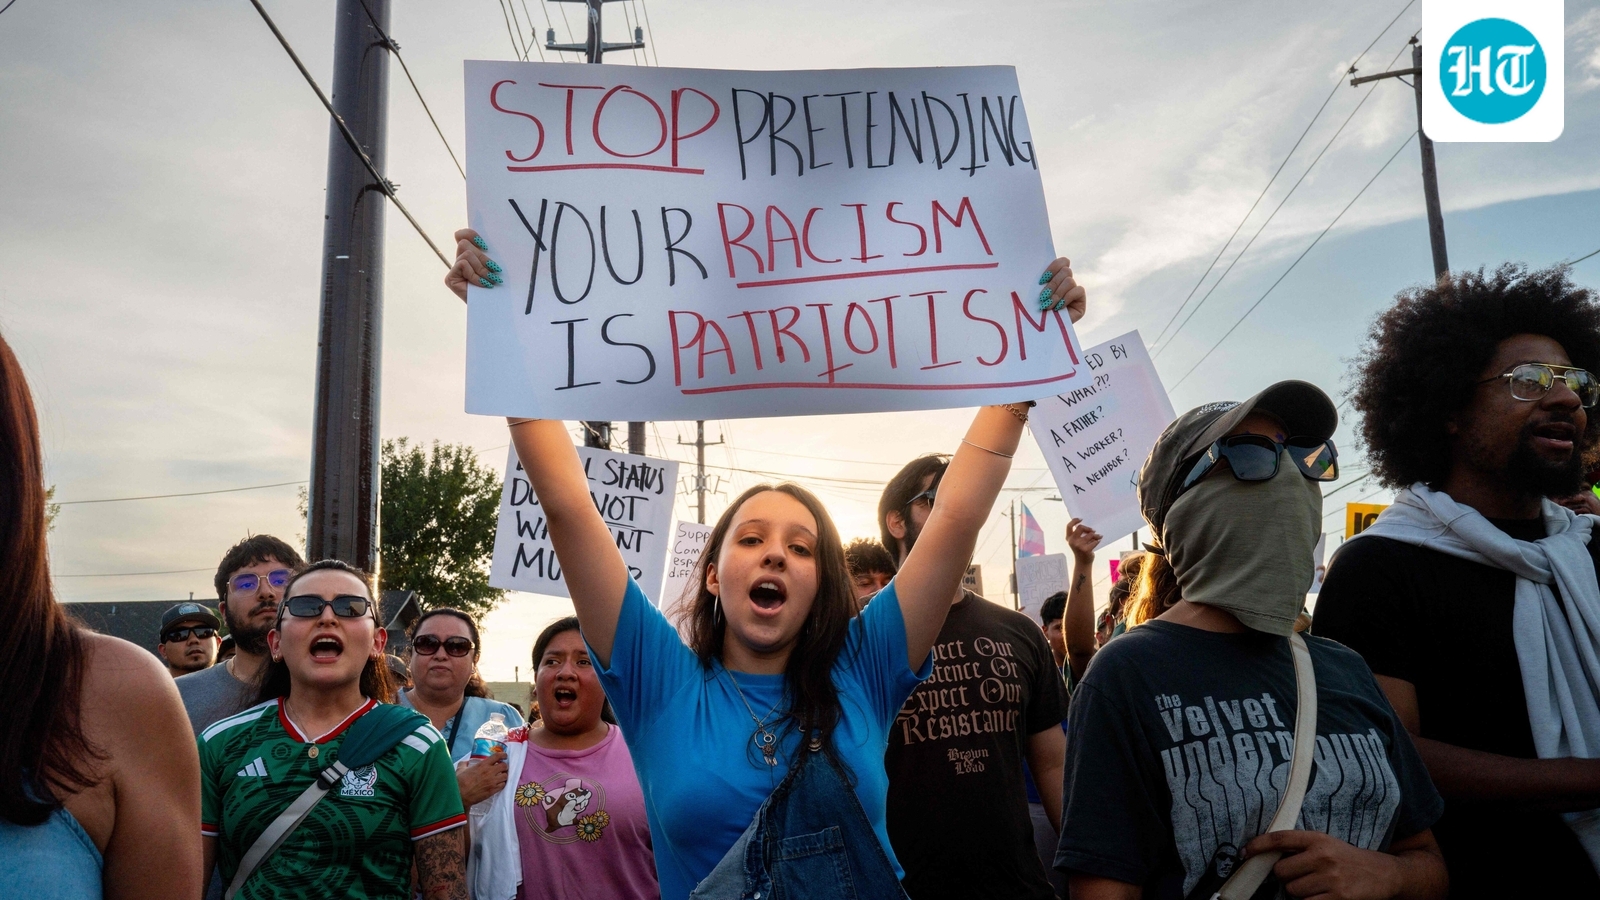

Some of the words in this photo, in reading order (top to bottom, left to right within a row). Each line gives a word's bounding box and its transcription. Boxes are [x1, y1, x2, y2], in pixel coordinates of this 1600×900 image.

[491, 80, 720, 167] STOP
[731, 87, 1037, 181] PRETENDING
[508, 198, 708, 315] YOUR
[717, 196, 993, 278] RACISM
[550, 313, 656, 390] IS
[668, 289, 1079, 386] PATRIOTISM
[1050, 428, 1066, 448] A
[1063, 405, 1105, 437] FATHER?
[1061, 456, 1077, 473] A
[1076, 428, 1126, 460] WORKER?
[590, 488, 649, 521] NOT
[1073, 483, 1086, 494] A
[932, 640, 966, 661] pect
[974, 636, 1014, 657] Our
[990, 657, 1018, 678] Or
[900, 685, 970, 715] Expect
[980, 677, 1021, 703] Our
[1155, 693, 1182, 711] the
[896, 709, 1020, 746] Resistance
